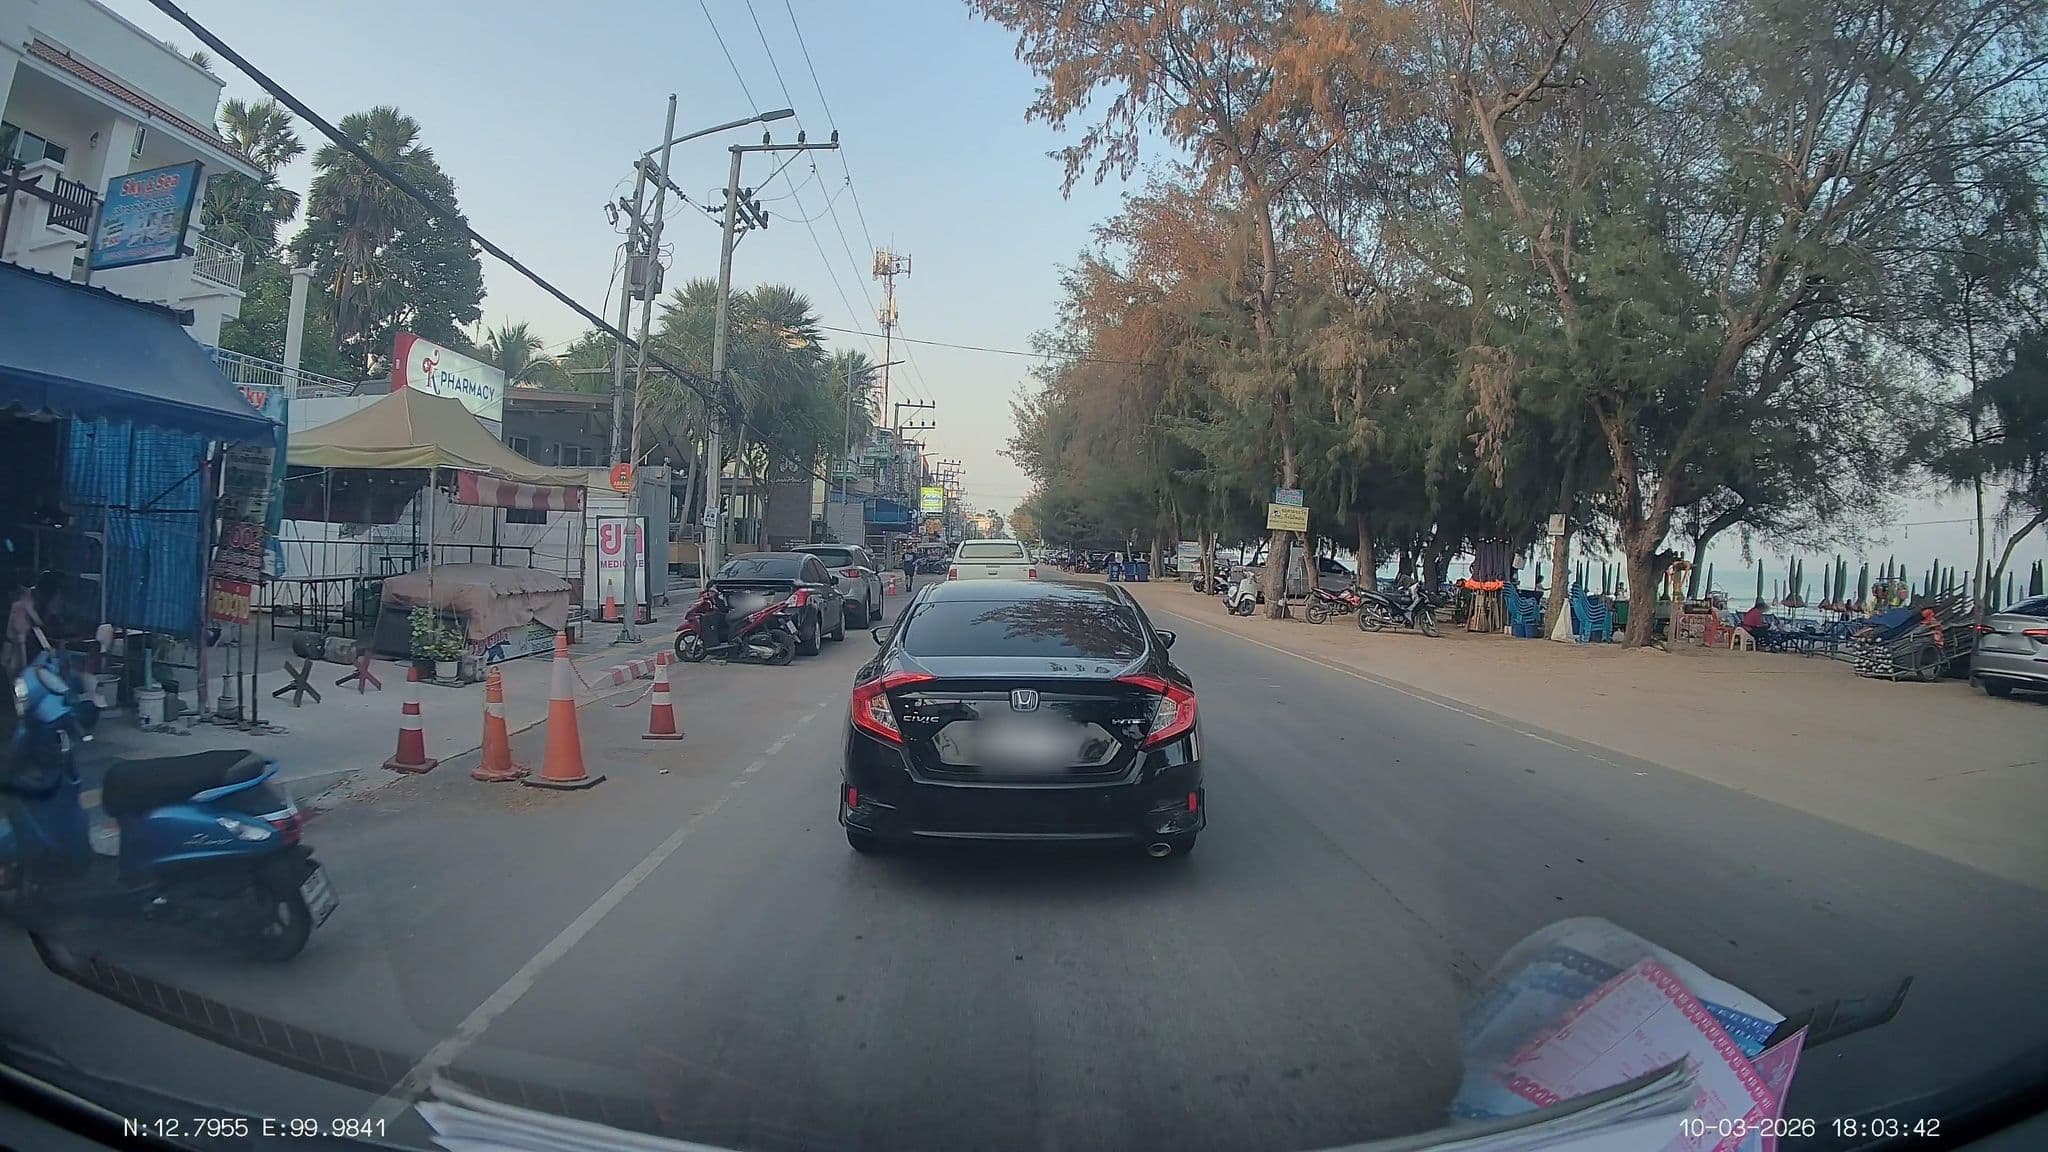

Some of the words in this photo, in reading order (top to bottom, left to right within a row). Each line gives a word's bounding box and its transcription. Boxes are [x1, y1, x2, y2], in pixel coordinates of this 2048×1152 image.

[441, 371, 495, 402] PHARMACY
[239, 387, 267, 411] ky
[600, 559, 646, 569] MEDICE
[903, 715, 939, 724] CIVIC
